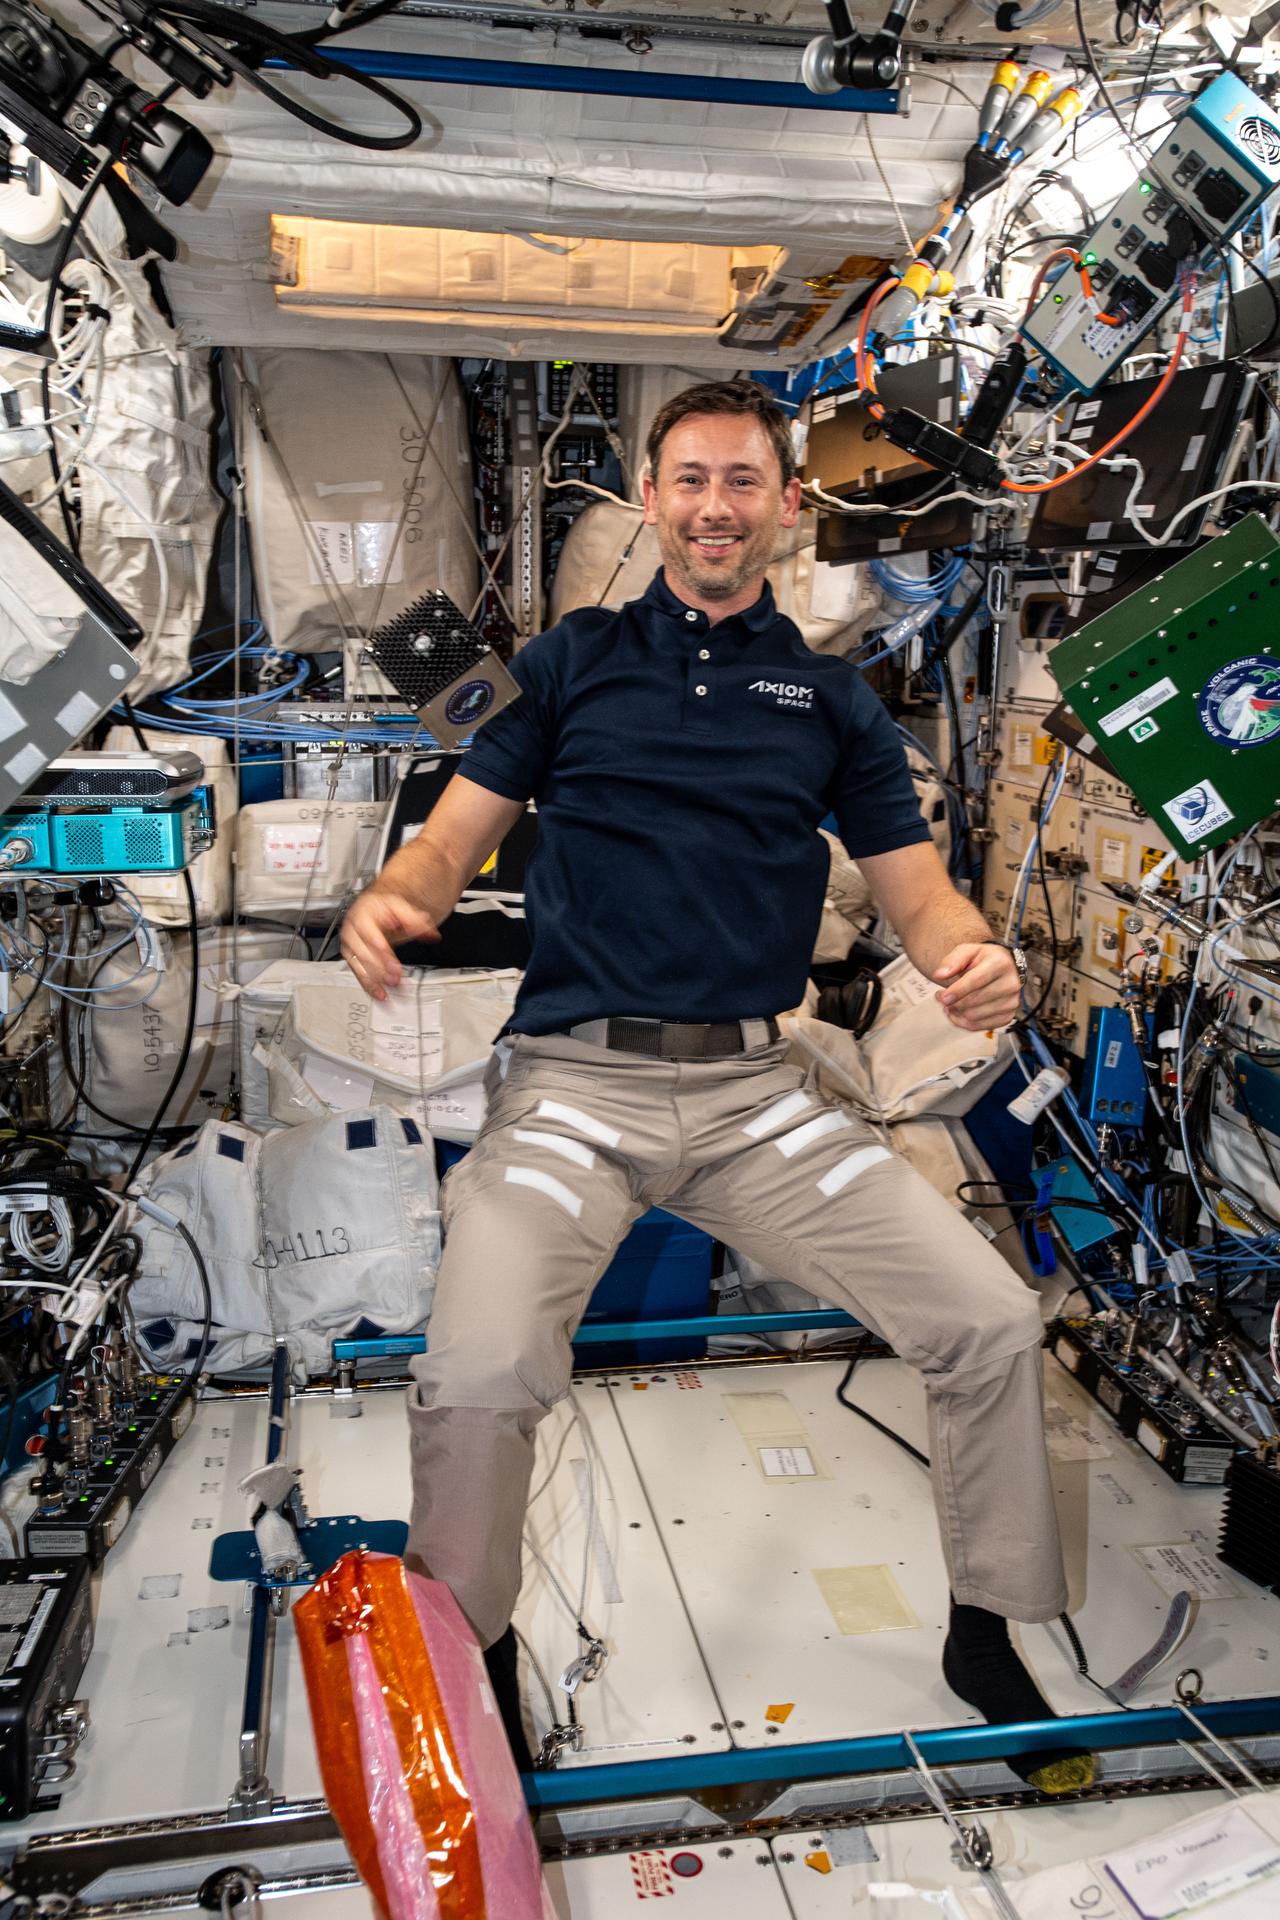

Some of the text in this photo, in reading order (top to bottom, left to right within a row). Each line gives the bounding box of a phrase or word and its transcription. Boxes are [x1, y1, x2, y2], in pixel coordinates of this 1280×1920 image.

[1206, 657, 1259, 690] VOLCANIC
[747, 680, 815, 700] AXIOM
[775, 697, 813, 709] SPACE
[1200, 709, 1221, 738] SPACE
[1184, 810, 1230, 840] ICECUBES
